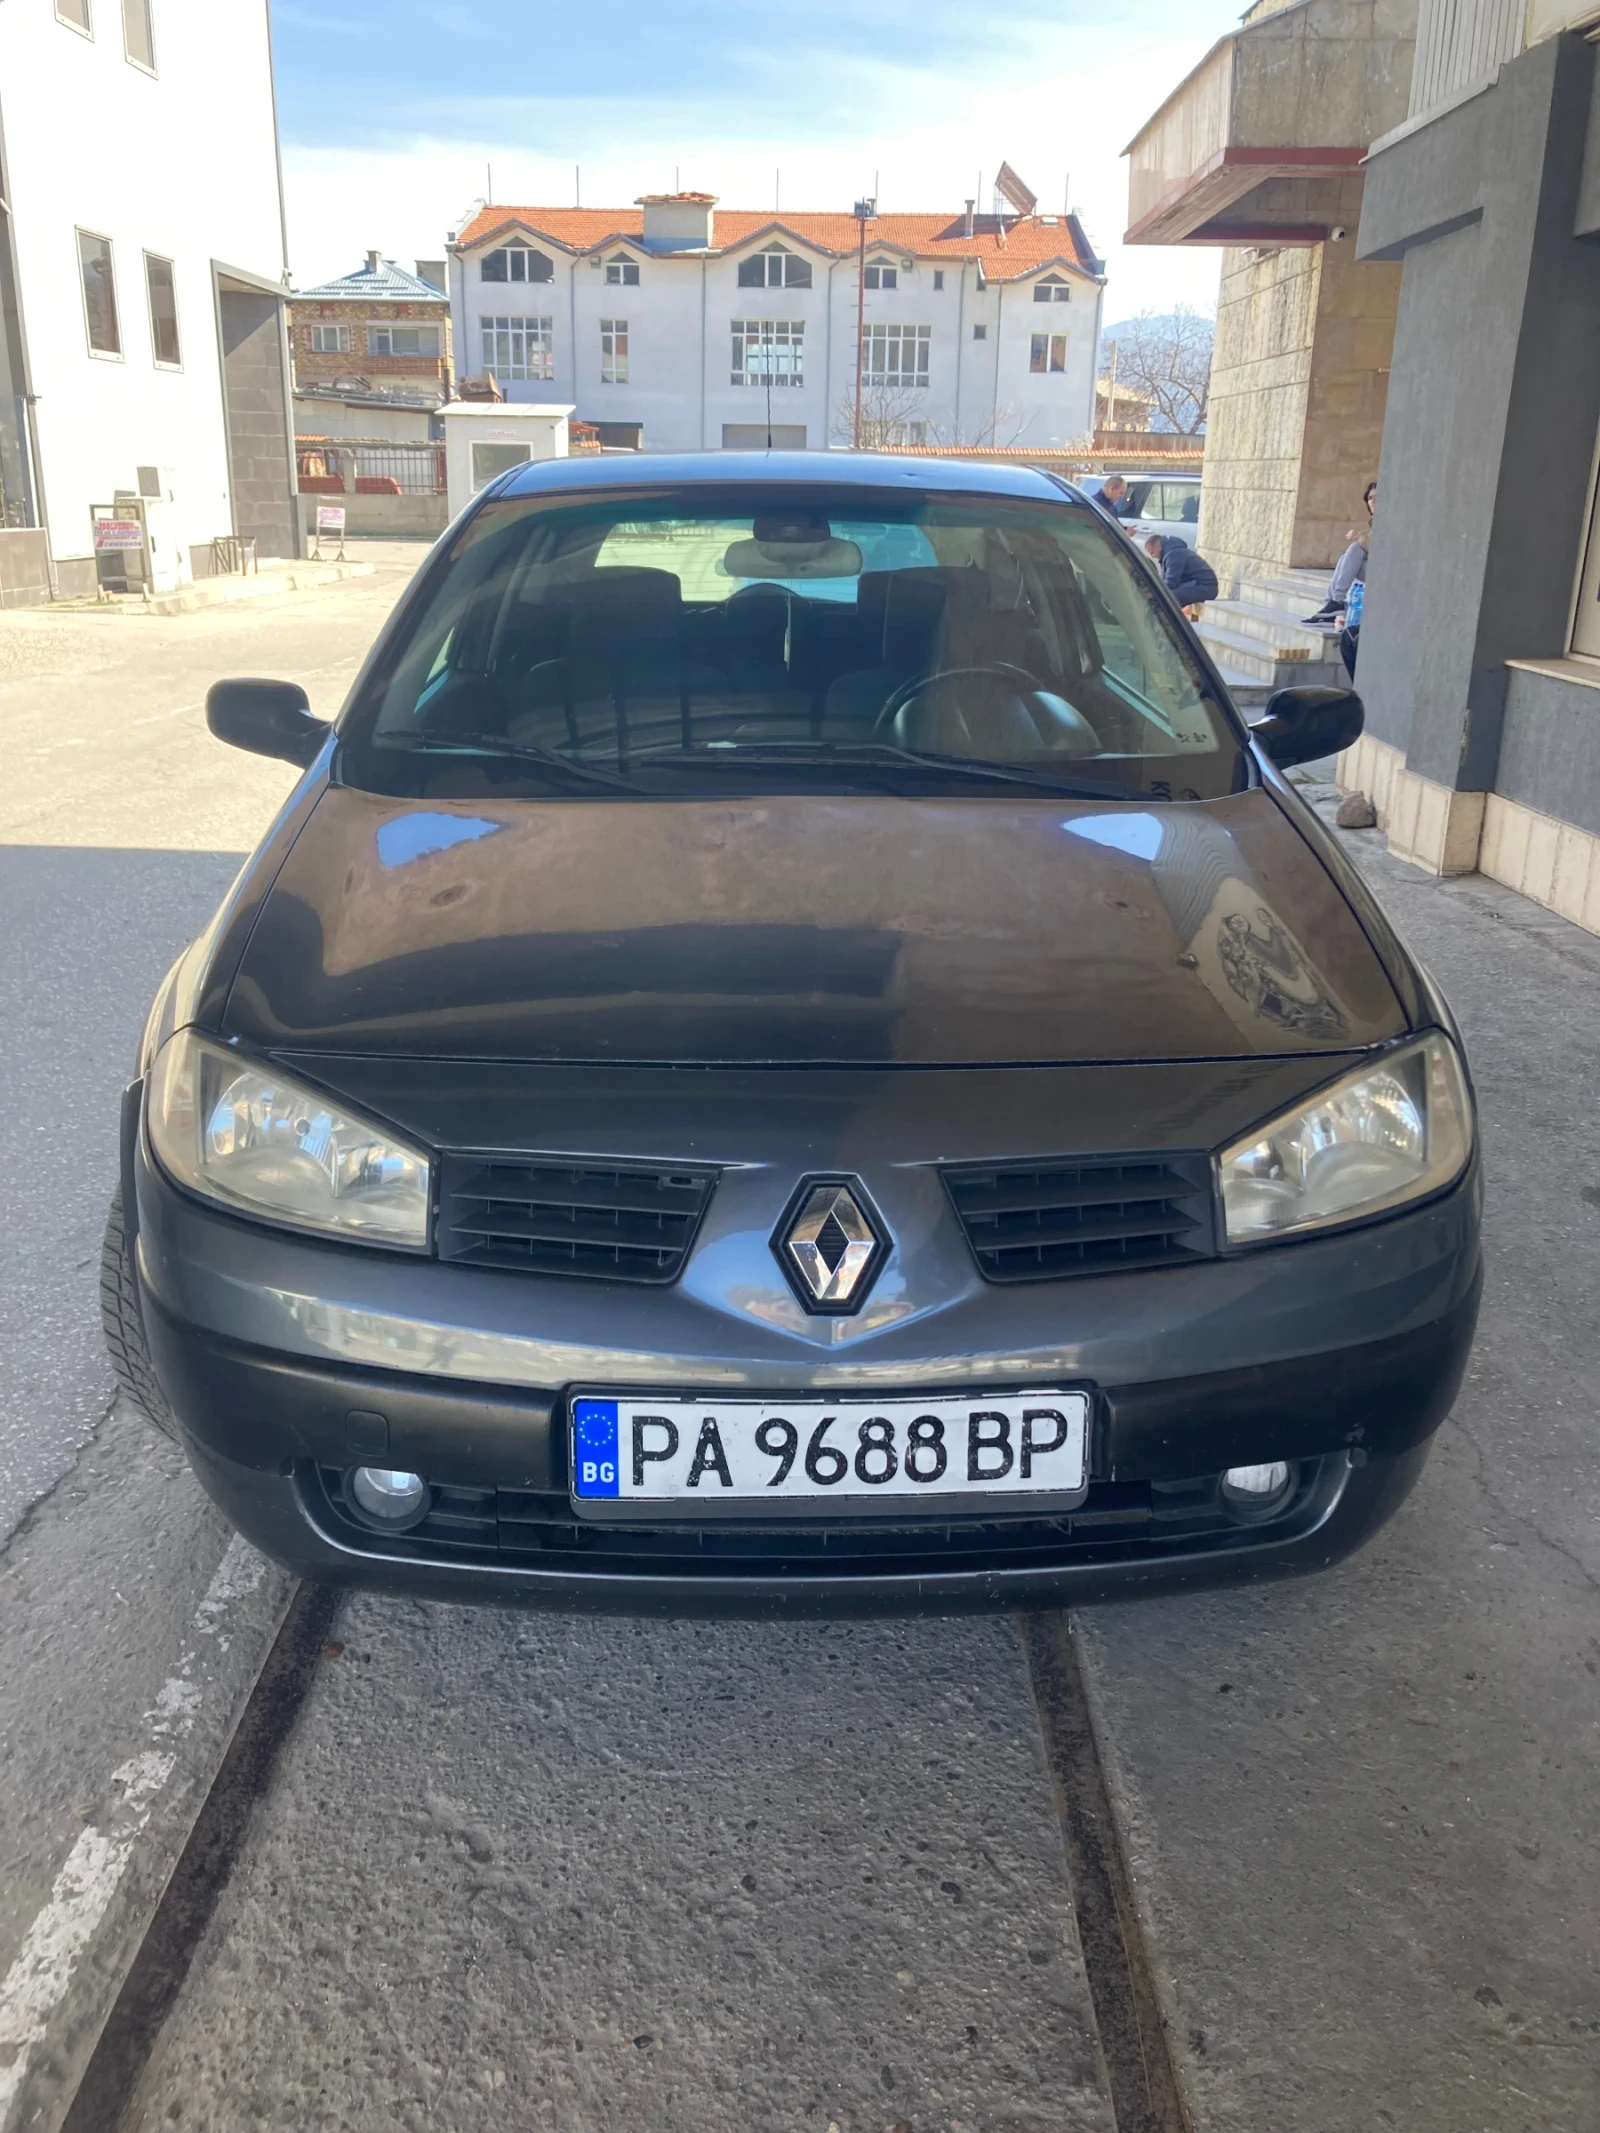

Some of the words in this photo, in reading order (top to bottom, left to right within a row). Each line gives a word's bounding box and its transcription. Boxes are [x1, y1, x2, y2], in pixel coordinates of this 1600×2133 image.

[582, 1461, 615, 1483] BG
[631, 1415, 734, 1487] PA
[754, 1414, 948, 1487] 9688
[966, 1408, 1068, 1482] BP
